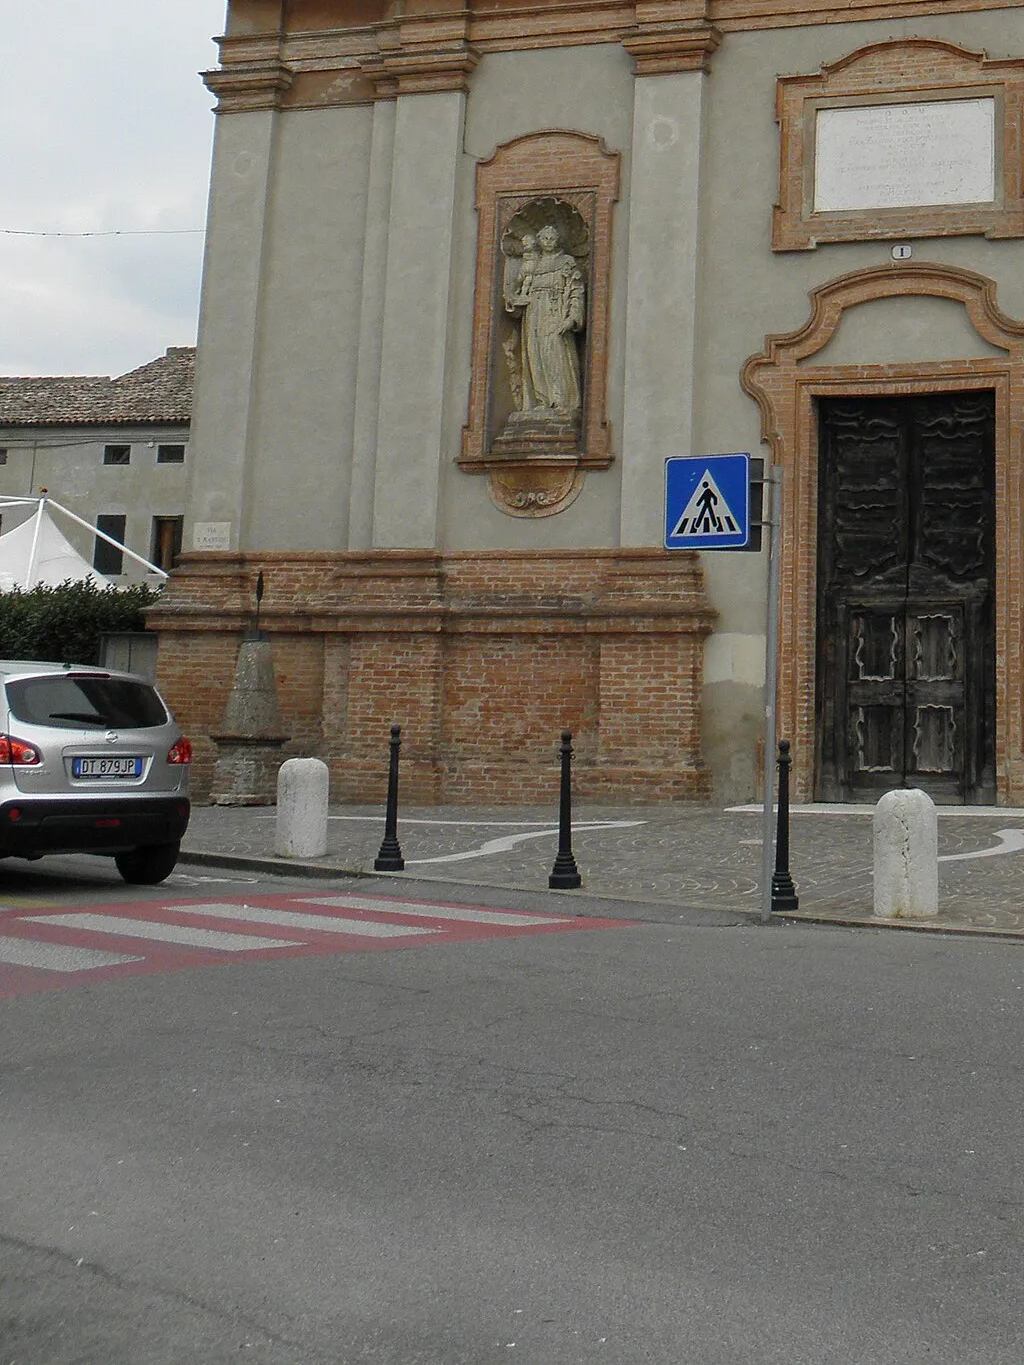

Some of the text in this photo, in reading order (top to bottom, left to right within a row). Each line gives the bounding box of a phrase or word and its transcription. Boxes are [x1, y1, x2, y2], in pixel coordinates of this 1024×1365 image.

[900, 247, 904, 257] 1
[82, 760, 134, 773] DT 879JP
